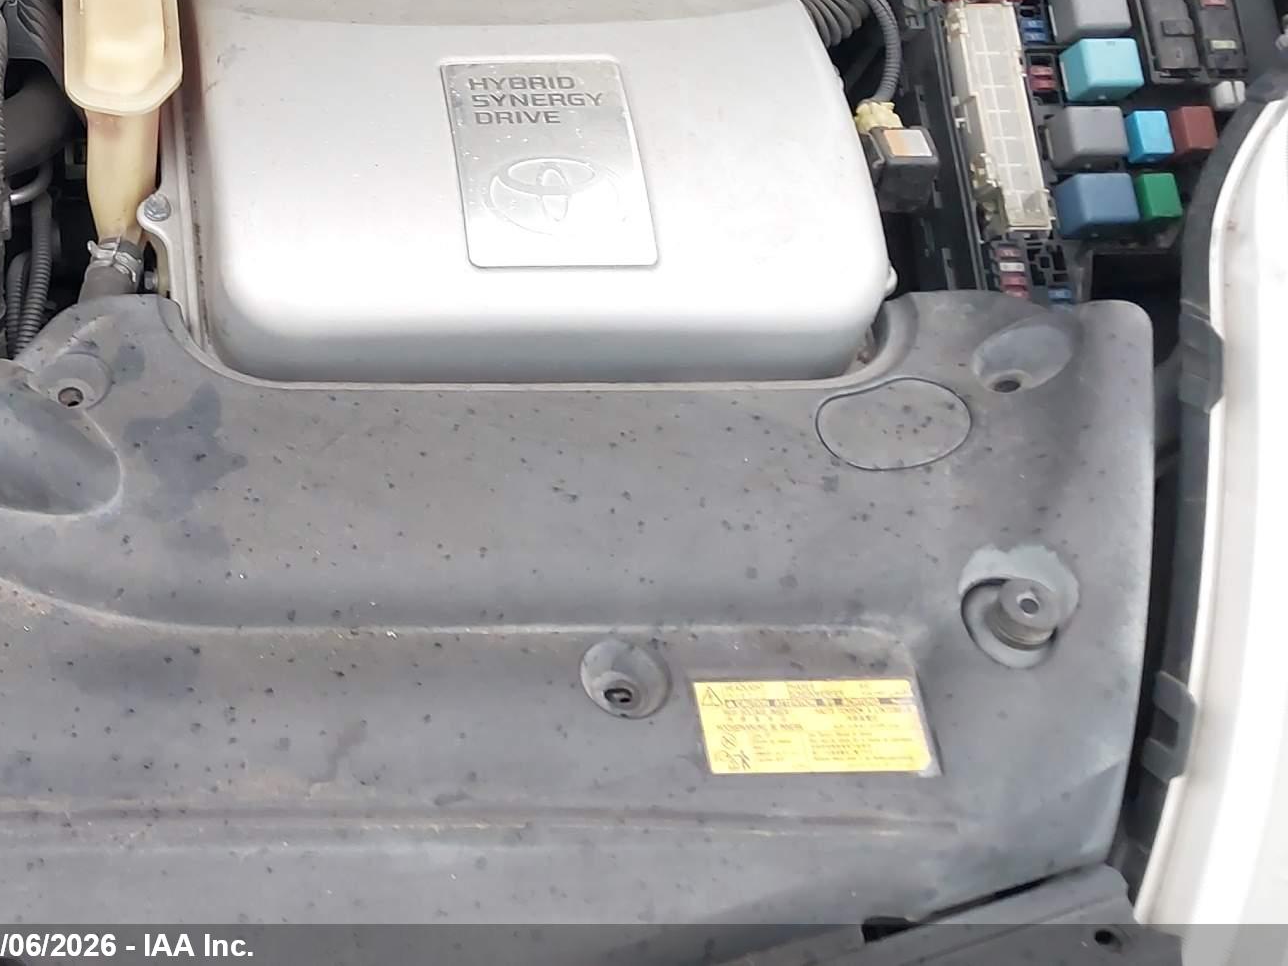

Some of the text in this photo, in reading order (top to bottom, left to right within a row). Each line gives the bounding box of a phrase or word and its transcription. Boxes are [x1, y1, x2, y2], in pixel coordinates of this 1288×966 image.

[468, 76, 576, 91] HYBRID
[471, 92, 603, 108] SYNERGY
[475, 111, 561, 125] DRIVE
